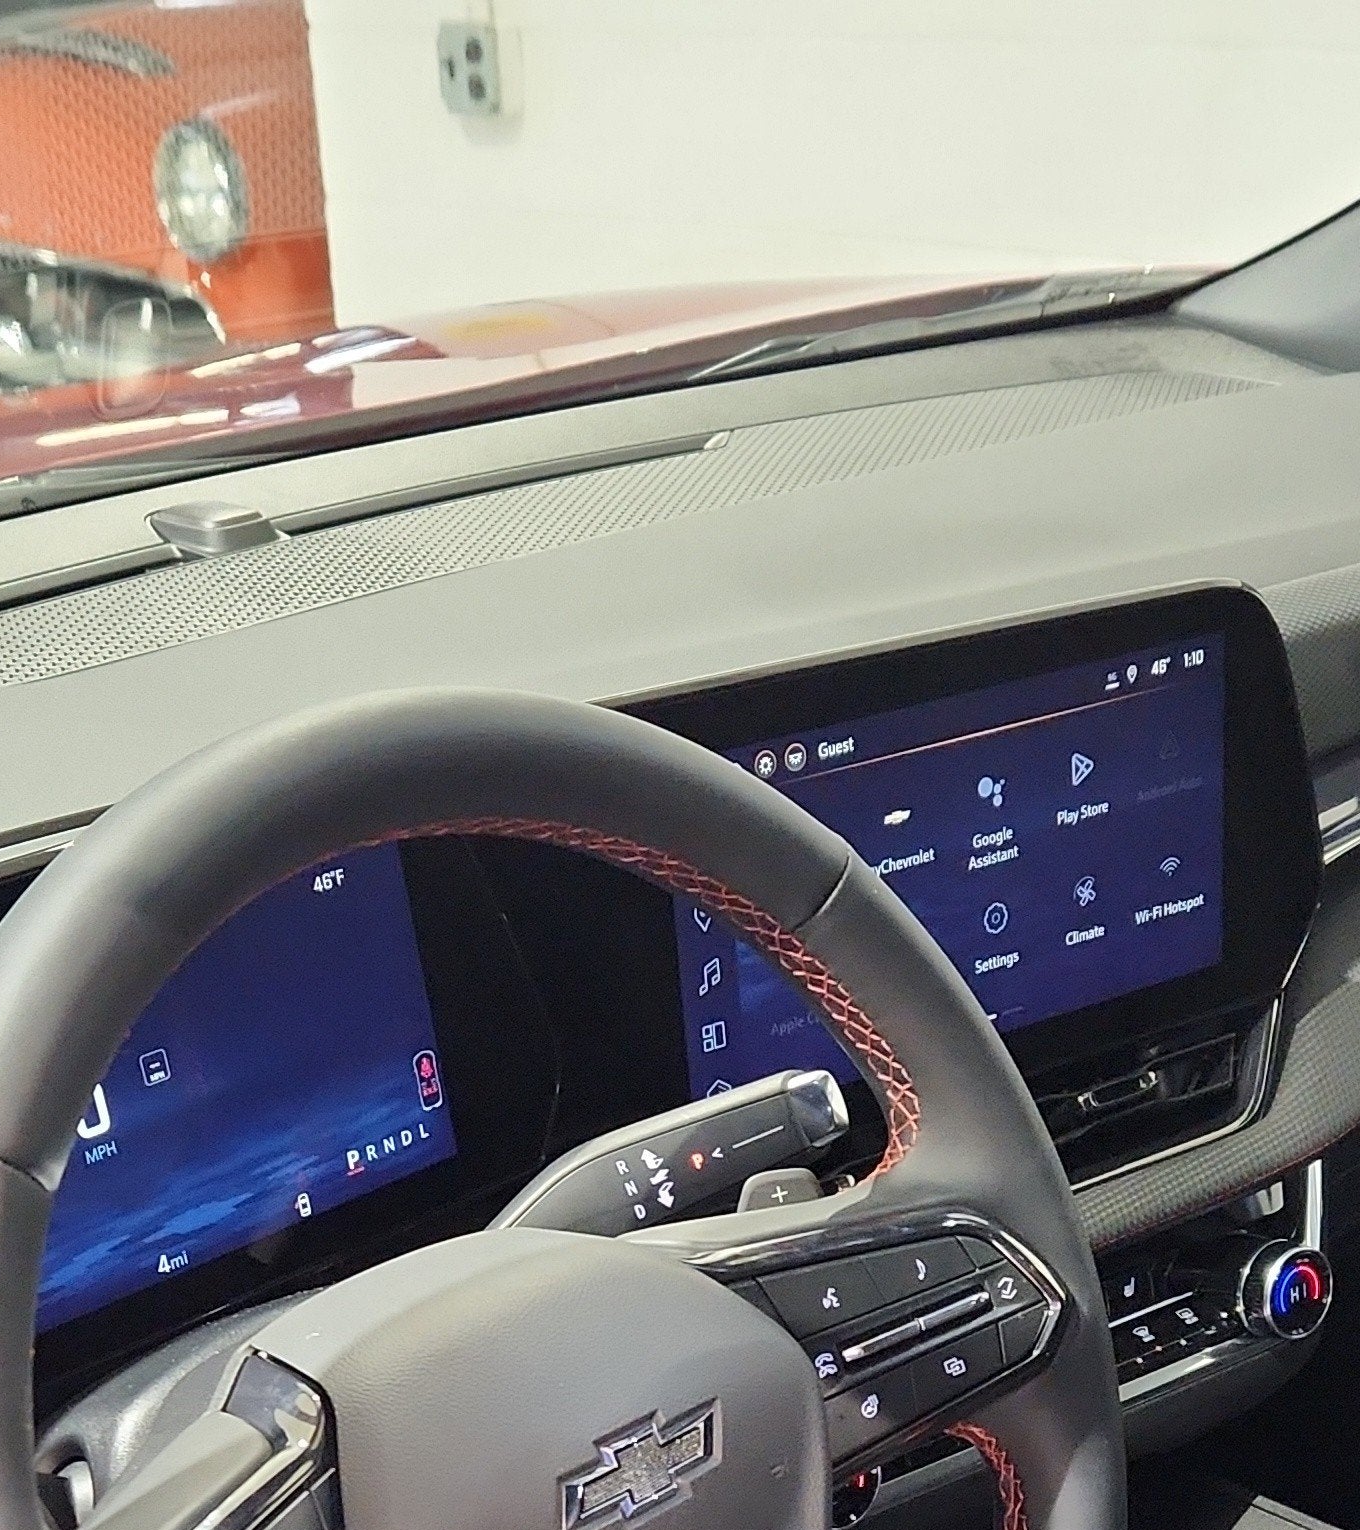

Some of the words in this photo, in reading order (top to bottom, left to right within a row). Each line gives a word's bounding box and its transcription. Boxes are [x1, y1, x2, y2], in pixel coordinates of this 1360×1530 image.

[1183, 649, 1205, 669] 1:10
[817, 736, 855, 761] Guest
[1057, 809, 1079, 826] Play
[1080, 802, 1109, 819] Store
[972, 826, 1014, 849] Google
[872, 848, 935, 877] yChevrolet
[968, 845, 1019, 871] Assistant
[313, 868, 345, 893] 46°F
[1135, 908, 1163, 926] Wi-Fi
[1164, 894, 1205, 918] Hotspot
[1065, 925, 1105, 946] Climate
[974, 951, 1020, 974] Settings
[770, 1017, 805, 1036] Apple
[85, 1140, 118, 1165] MPH
[692, 1153, 704, 1171] P
[615, 1160, 629, 1175] R
[624, 1180, 638, 1197] N
[634, 1204, 647, 1220] D
